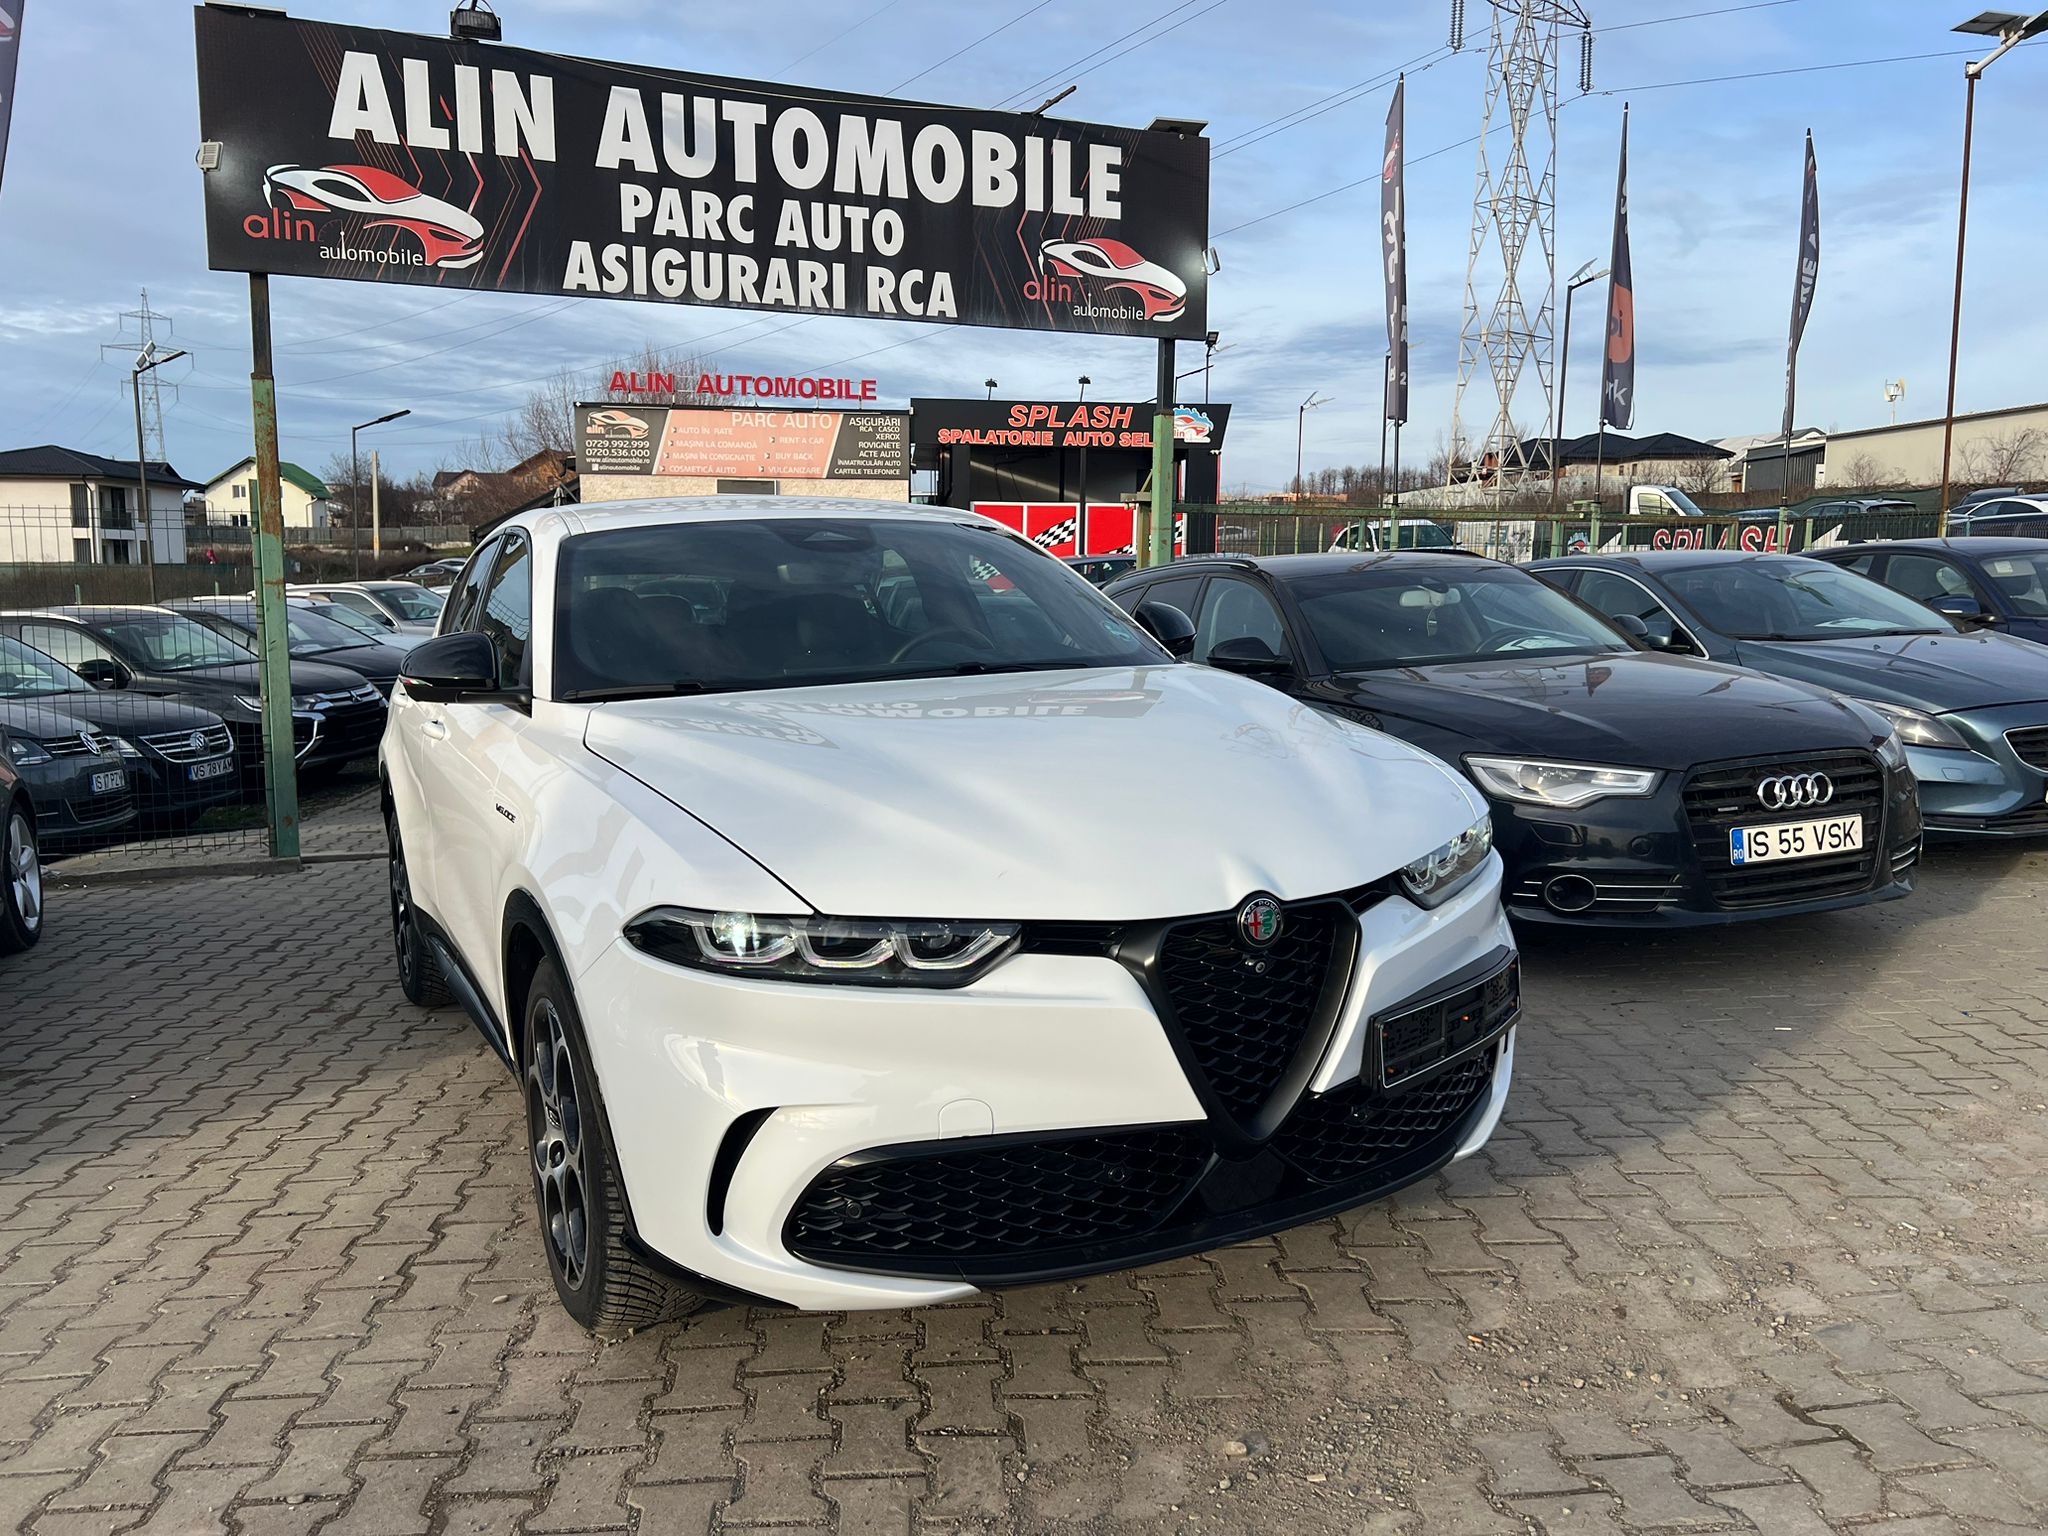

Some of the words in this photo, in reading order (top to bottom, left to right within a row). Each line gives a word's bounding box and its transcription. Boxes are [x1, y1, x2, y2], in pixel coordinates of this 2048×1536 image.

[328, 50, 557, 162] ALIN
[595, 85, 1122, 220] AUTOMOBILE
[243, 206, 316, 242] alin
[619, 182, 755, 244] PARC
[775, 198, 905, 257] AUTO
[320, 233, 423, 267] automobile
[562, 240, 846, 310] ASIGURARI
[866, 265, 958, 318] RCA
[1024, 274, 1072, 303] alin
[1073, 296, 1144, 321] automobile
[609, 371, 675, 393] ALIN
[696, 374, 877, 401] AUTOMOBILE
[731, 412, 778, 428] PARC
[783, 413, 833, 429] AUTO
[849, 416, 901, 426] ASIGURĂRI
[1008, 404, 1134, 429] SPLASH
[586, 425, 605, 434] alin
[937, 428, 1054, 446] SPALATORIE
[1063, 430, 1116, 447] AUTO
[585, 440, 650, 448] 0729.992.999
[585, 448, 650, 457] 0720.536.000
[858, 441, 900, 449] ROVIGNETE
[775, 452, 791, 460] BUY
[880, 450, 901, 458] AUTO
[715, 466, 737, 474] AUTO
[768, 466, 821, 474] VULCANIZARE
[1747, 830, 1769, 859] IS
[1778, 827, 1805, 855] 55
[1813, 820, 1856, 851] VSK
[1733, 848, 1744, 860] RO
